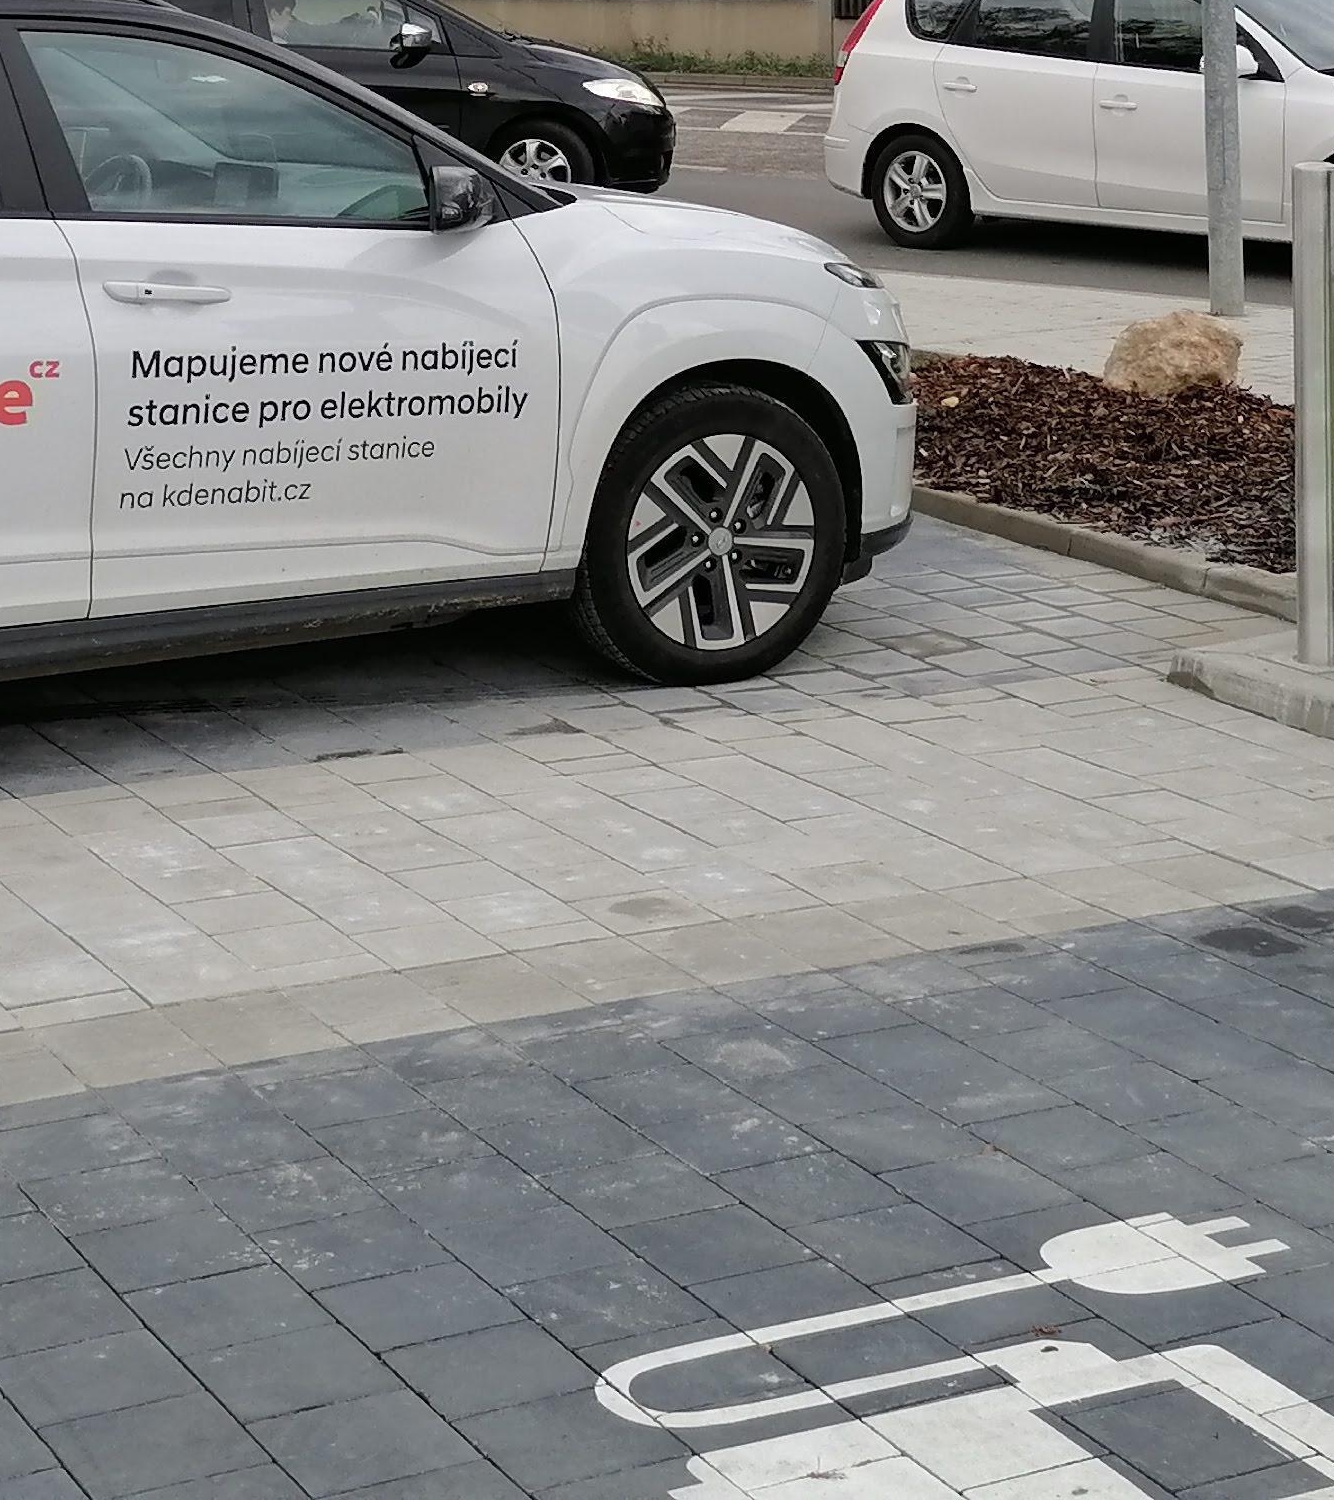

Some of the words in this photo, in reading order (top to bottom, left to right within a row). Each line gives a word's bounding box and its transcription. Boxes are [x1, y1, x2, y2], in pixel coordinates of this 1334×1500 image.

[130, 345, 309, 384] Mapujeme
[317, 343, 394, 375] nové
[401, 338, 519, 377] nabíjecí
[126, 393, 251, 428] stanice
[258, 399, 312, 429] pro
[319, 385, 529, 421] elektromobily
[123, 444, 236, 473] Všechny
[241, 437, 343, 468] nabíjecí
[346, 435, 436, 462] stanice
[119, 490, 155, 510] na
[162, 478, 312, 509] kdenabit.cz
